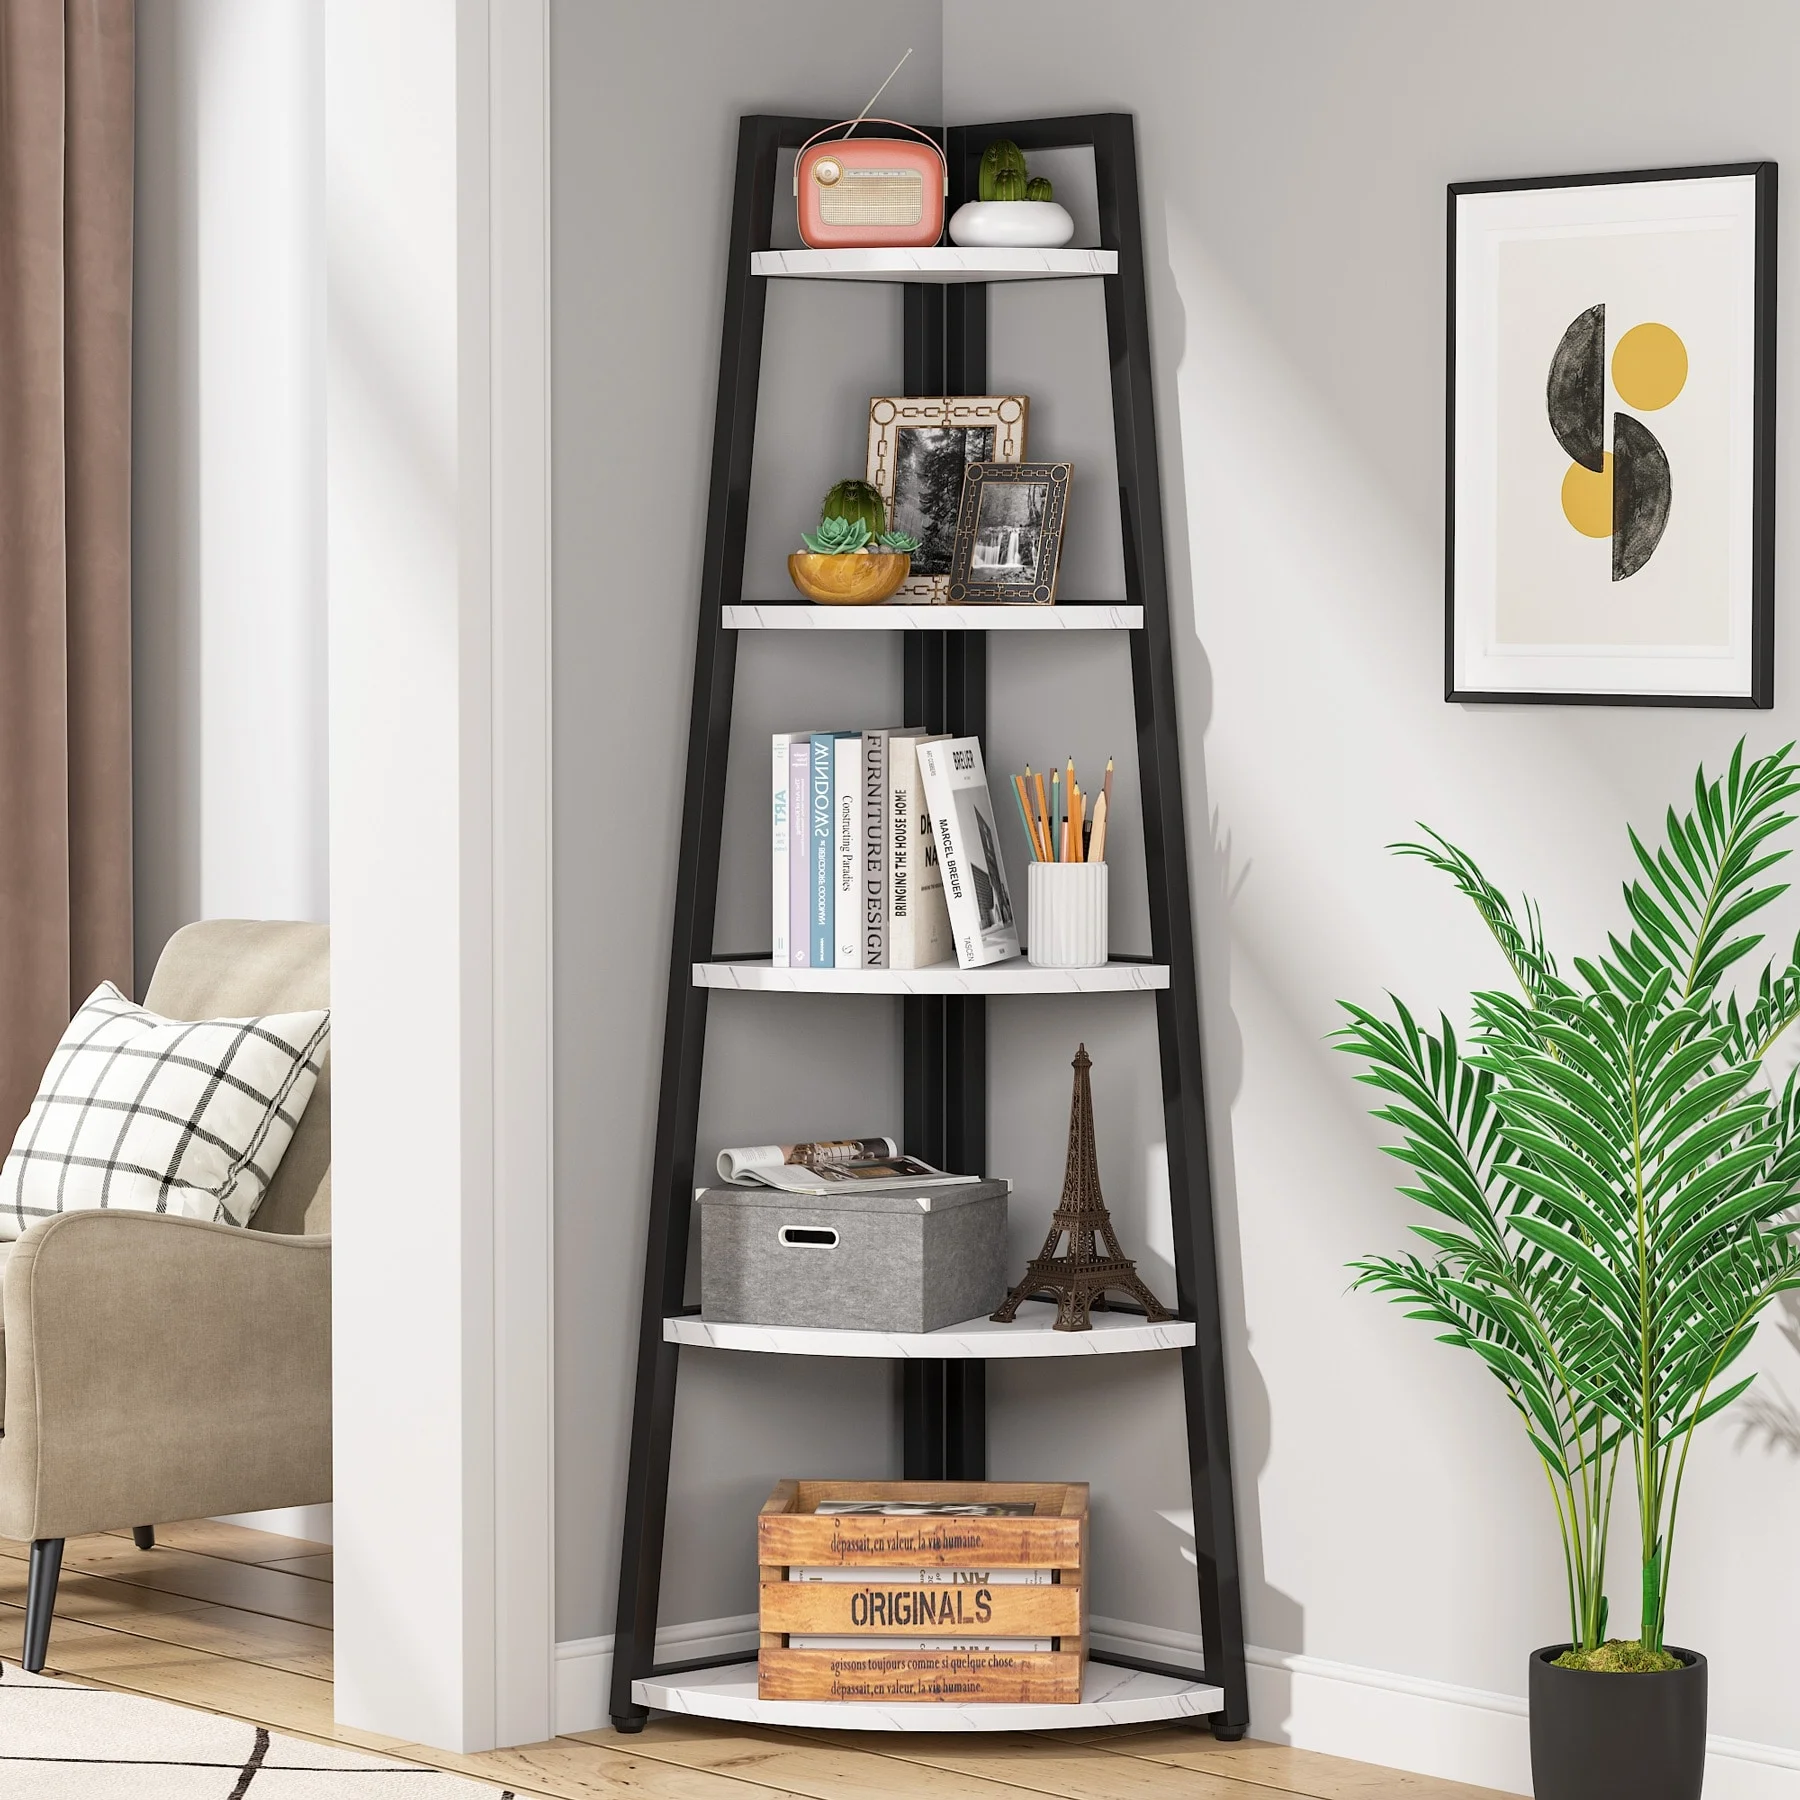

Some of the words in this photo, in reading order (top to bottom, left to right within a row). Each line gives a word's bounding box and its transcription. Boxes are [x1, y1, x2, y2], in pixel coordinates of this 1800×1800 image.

[867, 735, 882, 871] FURNITURE
[895, 790, 906, 816] HOME
[840, 795, 853, 852] Constructing
[895, 818, 906, 848] HOUSE
[895, 851, 906, 869] THE
[939, 818, 954, 858] MARCEL
[947, 860, 963, 899] BREUER
[895, 872, 906, 917] BRINGING
[867, 880, 882, 966] DESIGN
[887, 1530, 917, 1552] valeur,
[918, 1529, 926, 1550] la
[943, 1528, 984, 1550] humaine.
[851, 1588, 992, 1626] ORIGINALS
[830, 1657, 866, 1677] agissons
[868, 1657, 906, 1674] toujours
[907, 1659, 940, 1670] comme
[942, 1655, 948, 1669] si
[950, 1653, 986, 1674] quelque
[887, 1679, 917, 1696] valeur,
[918, 1678, 926, 1694] la
[943, 1677, 984, 1694] humaine.
